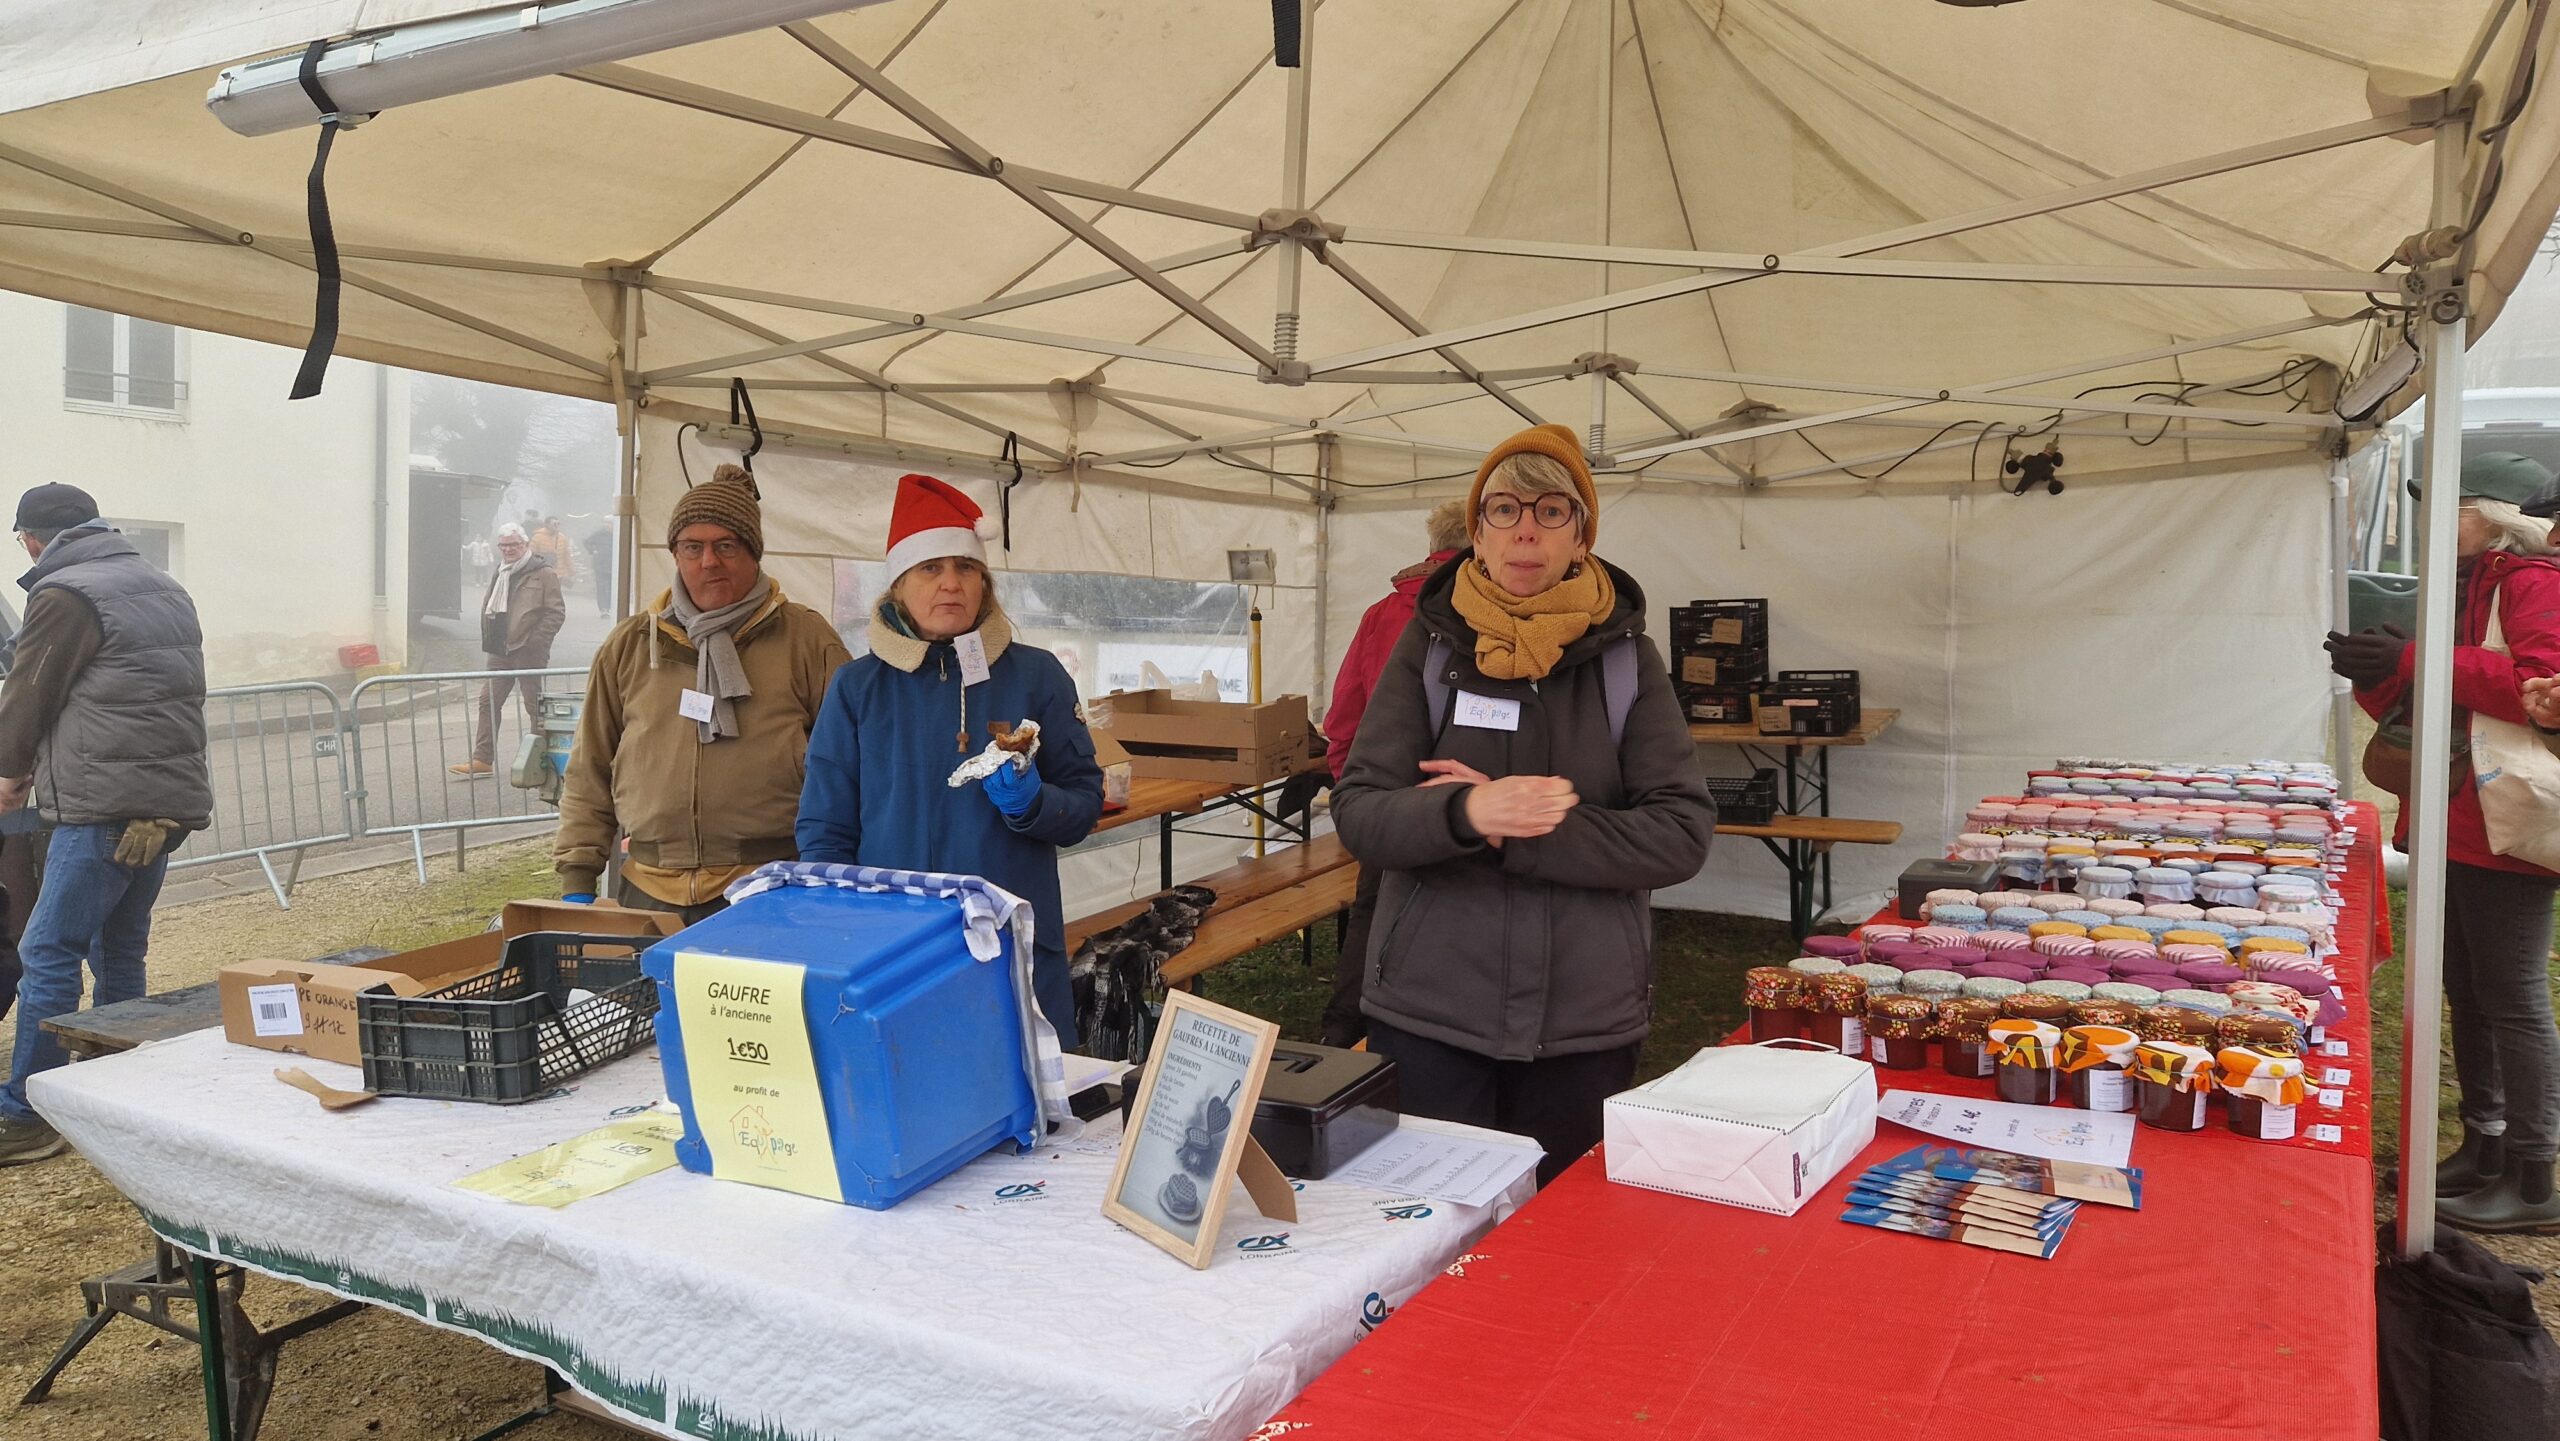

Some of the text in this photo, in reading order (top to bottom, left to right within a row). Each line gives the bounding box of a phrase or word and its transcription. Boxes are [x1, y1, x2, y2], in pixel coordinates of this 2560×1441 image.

[315, 993, 357, 1010] ORANGE
[708, 982, 771, 1005] GAUFRE
[710, 1003, 717, 1016] à
[1192, 1019, 1242, 1047] RECETTE DE
[727, 1037, 769, 1061] 1€50
[1173, 1028, 1203, 1049] GAUFRES
[1210, 1042, 1251, 1068] L'ANCIENNE
[733, 1084, 780, 1098] au profit de
